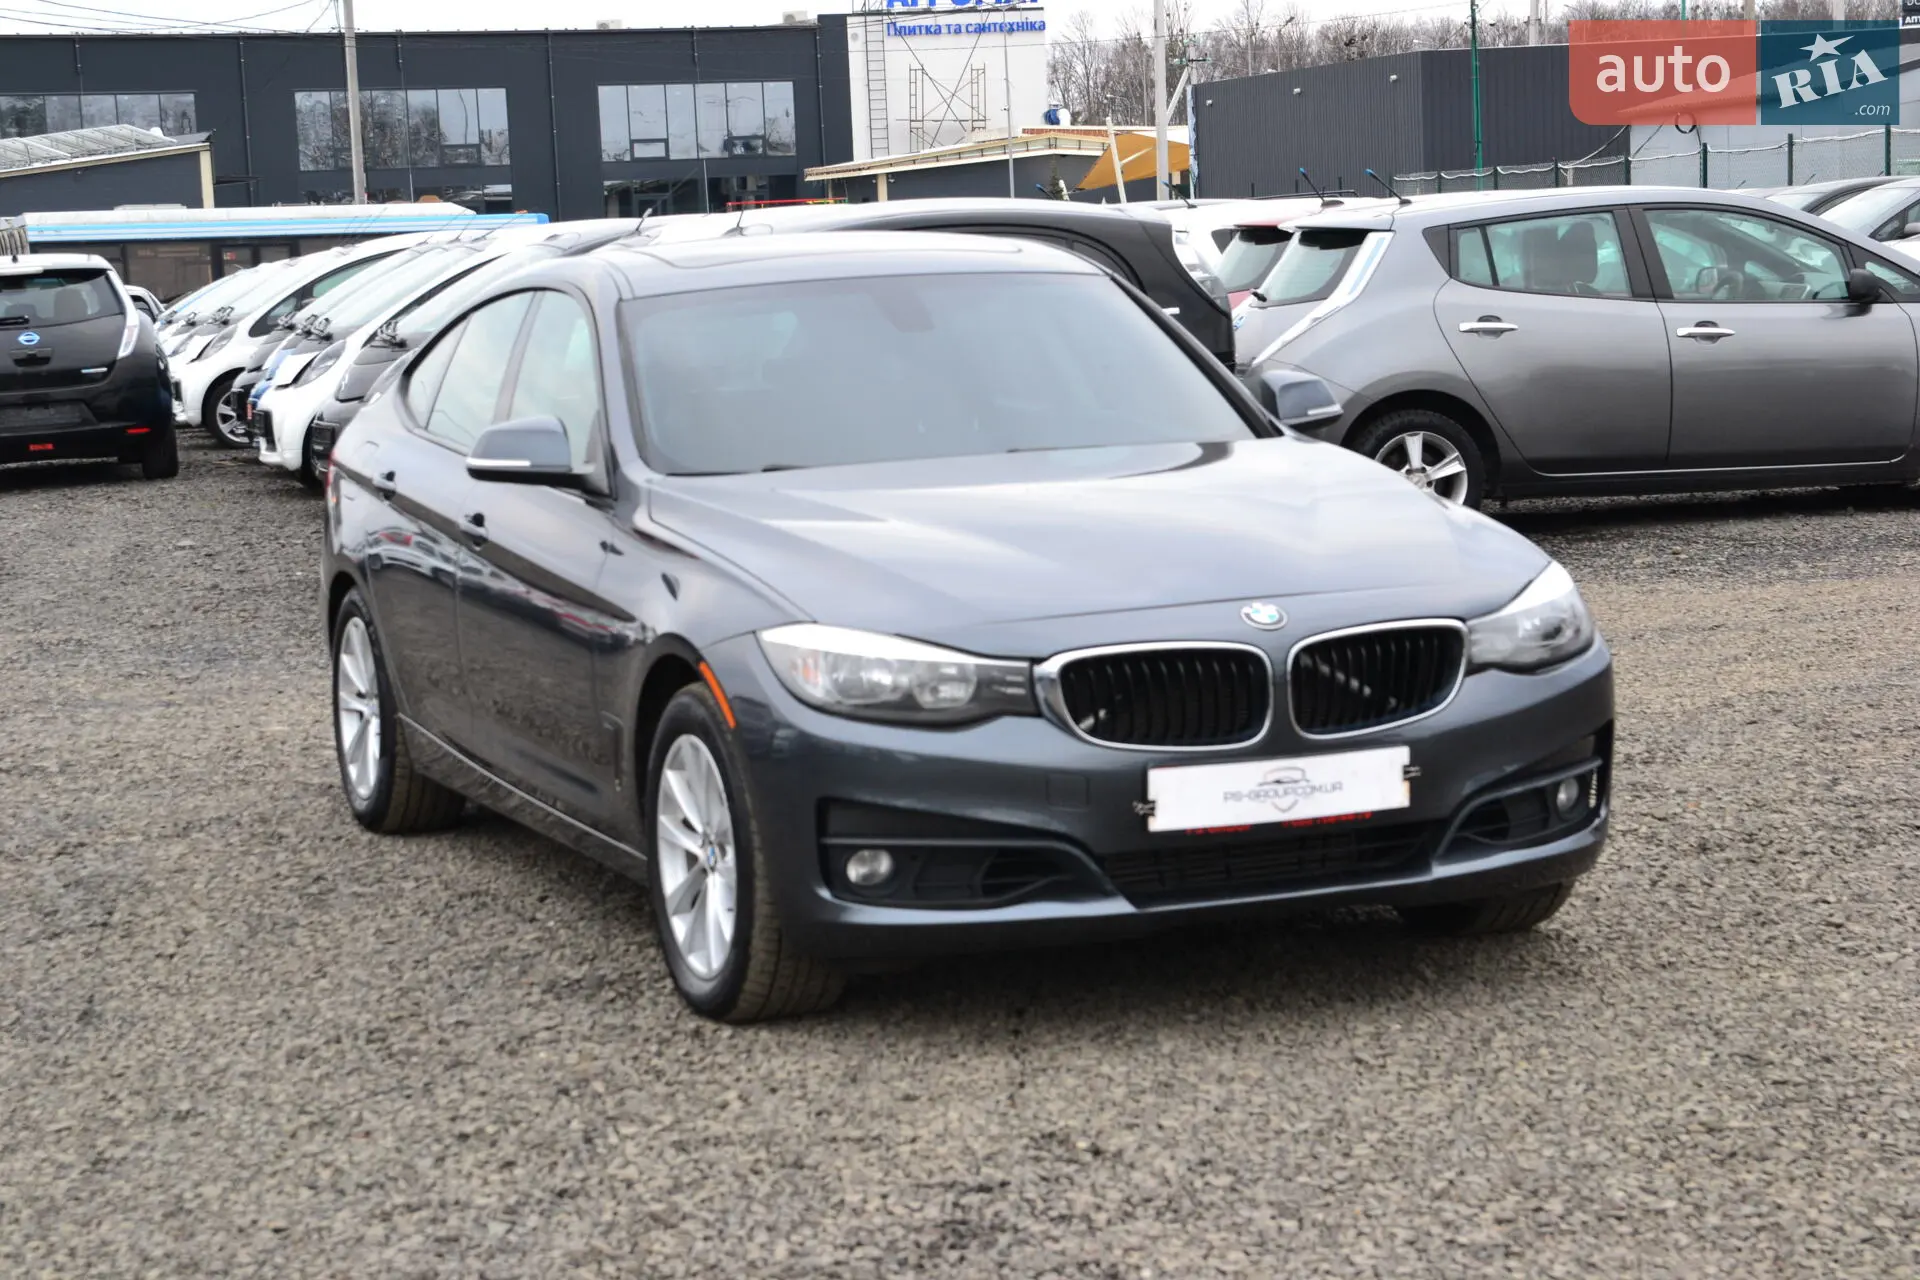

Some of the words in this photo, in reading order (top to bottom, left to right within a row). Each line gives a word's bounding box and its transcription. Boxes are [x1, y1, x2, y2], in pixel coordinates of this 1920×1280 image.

[887, 21, 942, 37] Плитка
[947, 22, 962, 34] та
[965, 17, 1046, 34] сантехніка
